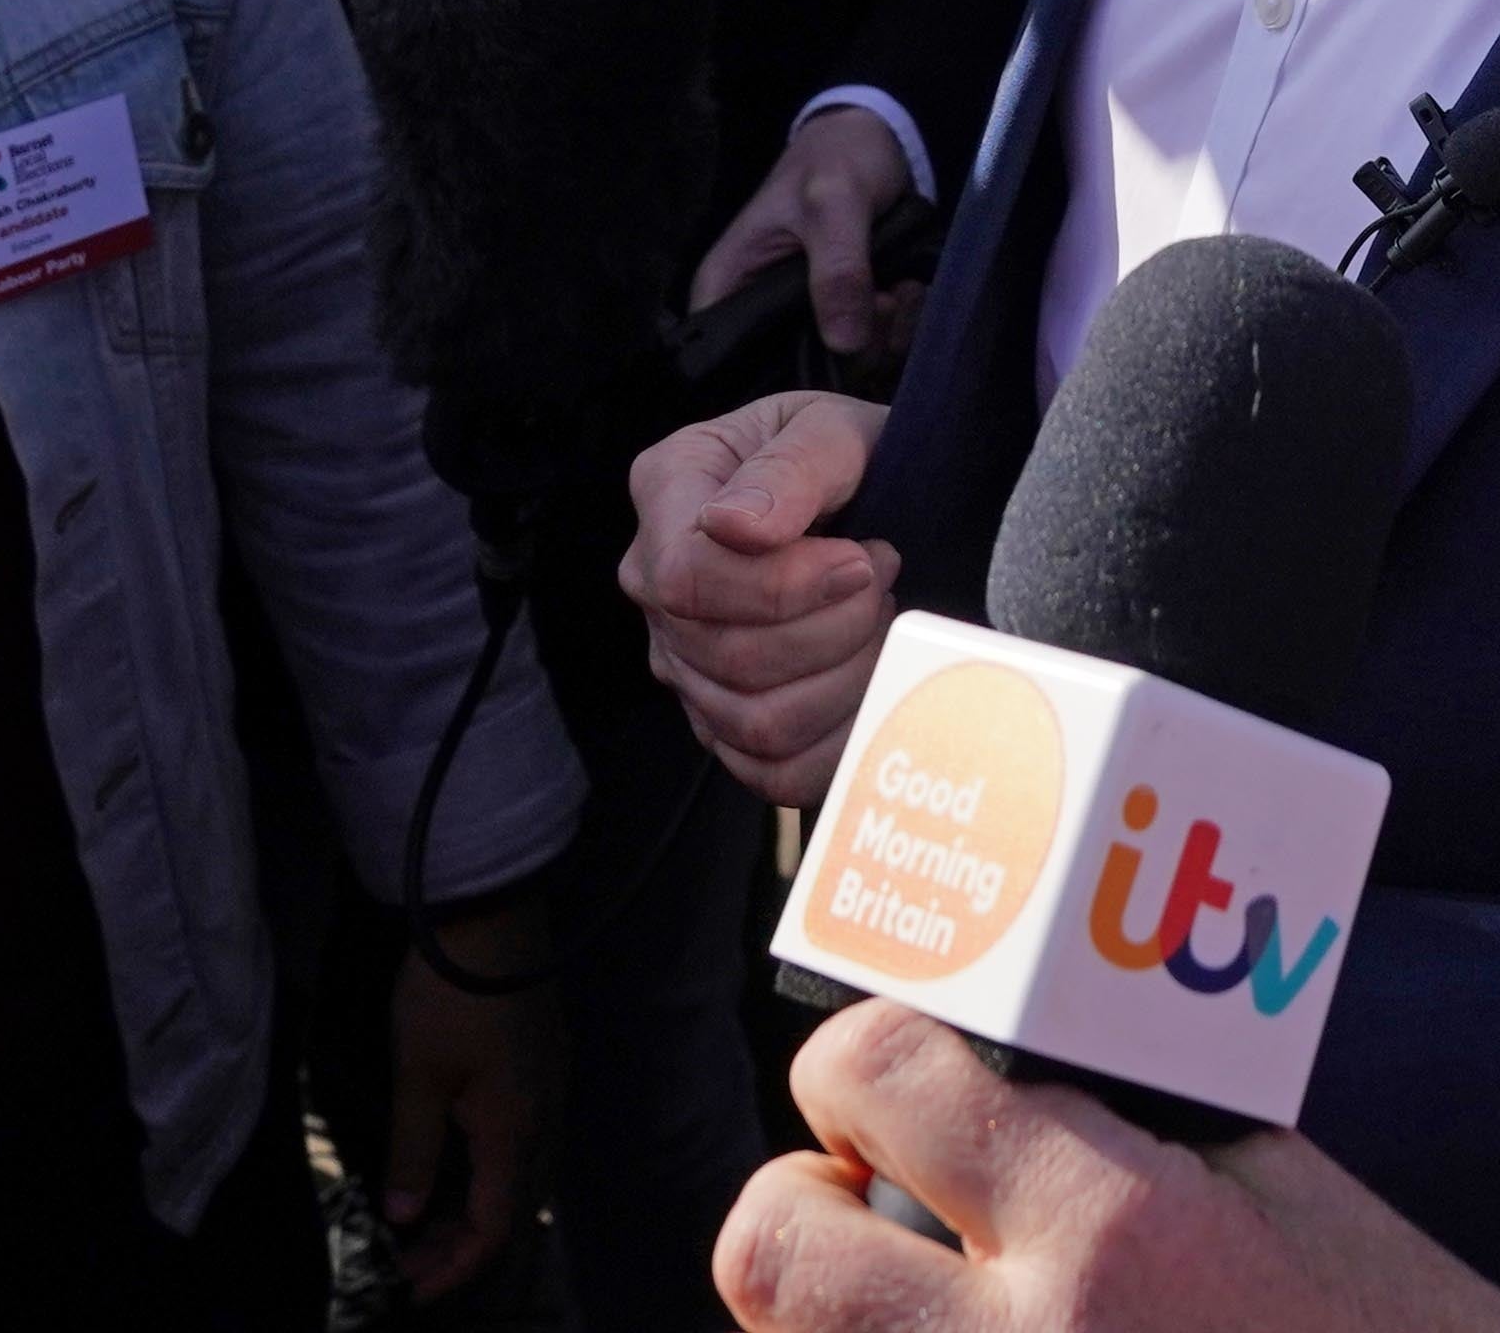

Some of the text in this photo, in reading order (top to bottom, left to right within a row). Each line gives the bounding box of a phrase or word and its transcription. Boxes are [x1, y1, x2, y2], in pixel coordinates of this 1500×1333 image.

[8, 133, 54, 158] Barnet
[45, 251, 87, 275] Party
[876, 748, 985, 825] Good
[852, 807, 1006, 915] Morning
[1088, 782, 1340, 1018] itv
[830, 866, 956, 956] Britain
